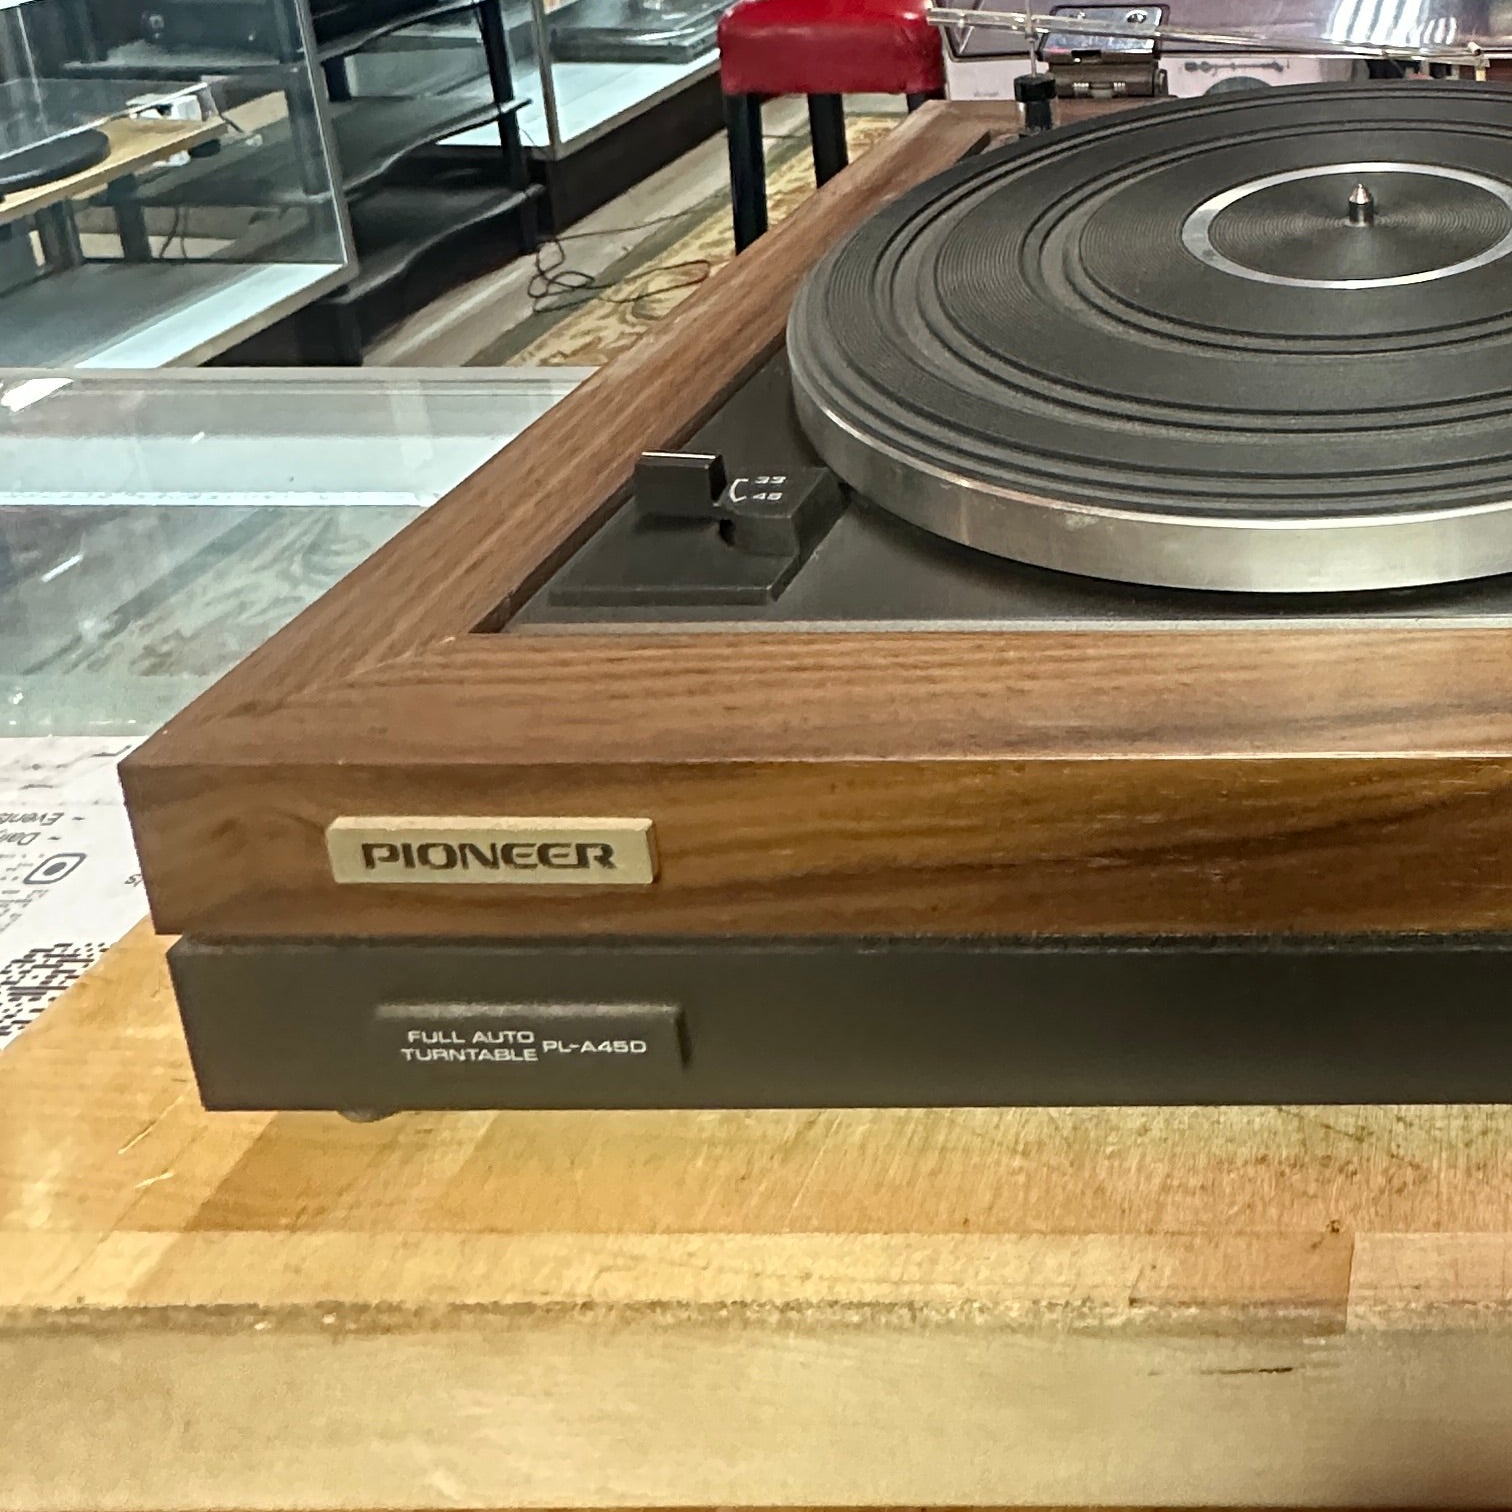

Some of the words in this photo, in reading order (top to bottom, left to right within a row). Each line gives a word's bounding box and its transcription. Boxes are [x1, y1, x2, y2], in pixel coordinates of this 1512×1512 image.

[755, 475, 787, 485] 33
[752, 491, 784, 501] 45
[361, 842, 620, 871] PIONEER
[407, 1029, 466, 1044] FULL
[471, 1029, 536, 1044] AUTO
[542, 1039, 648, 1054] PL-A45D
[401, 1047, 539, 1063] TURNTABLE
